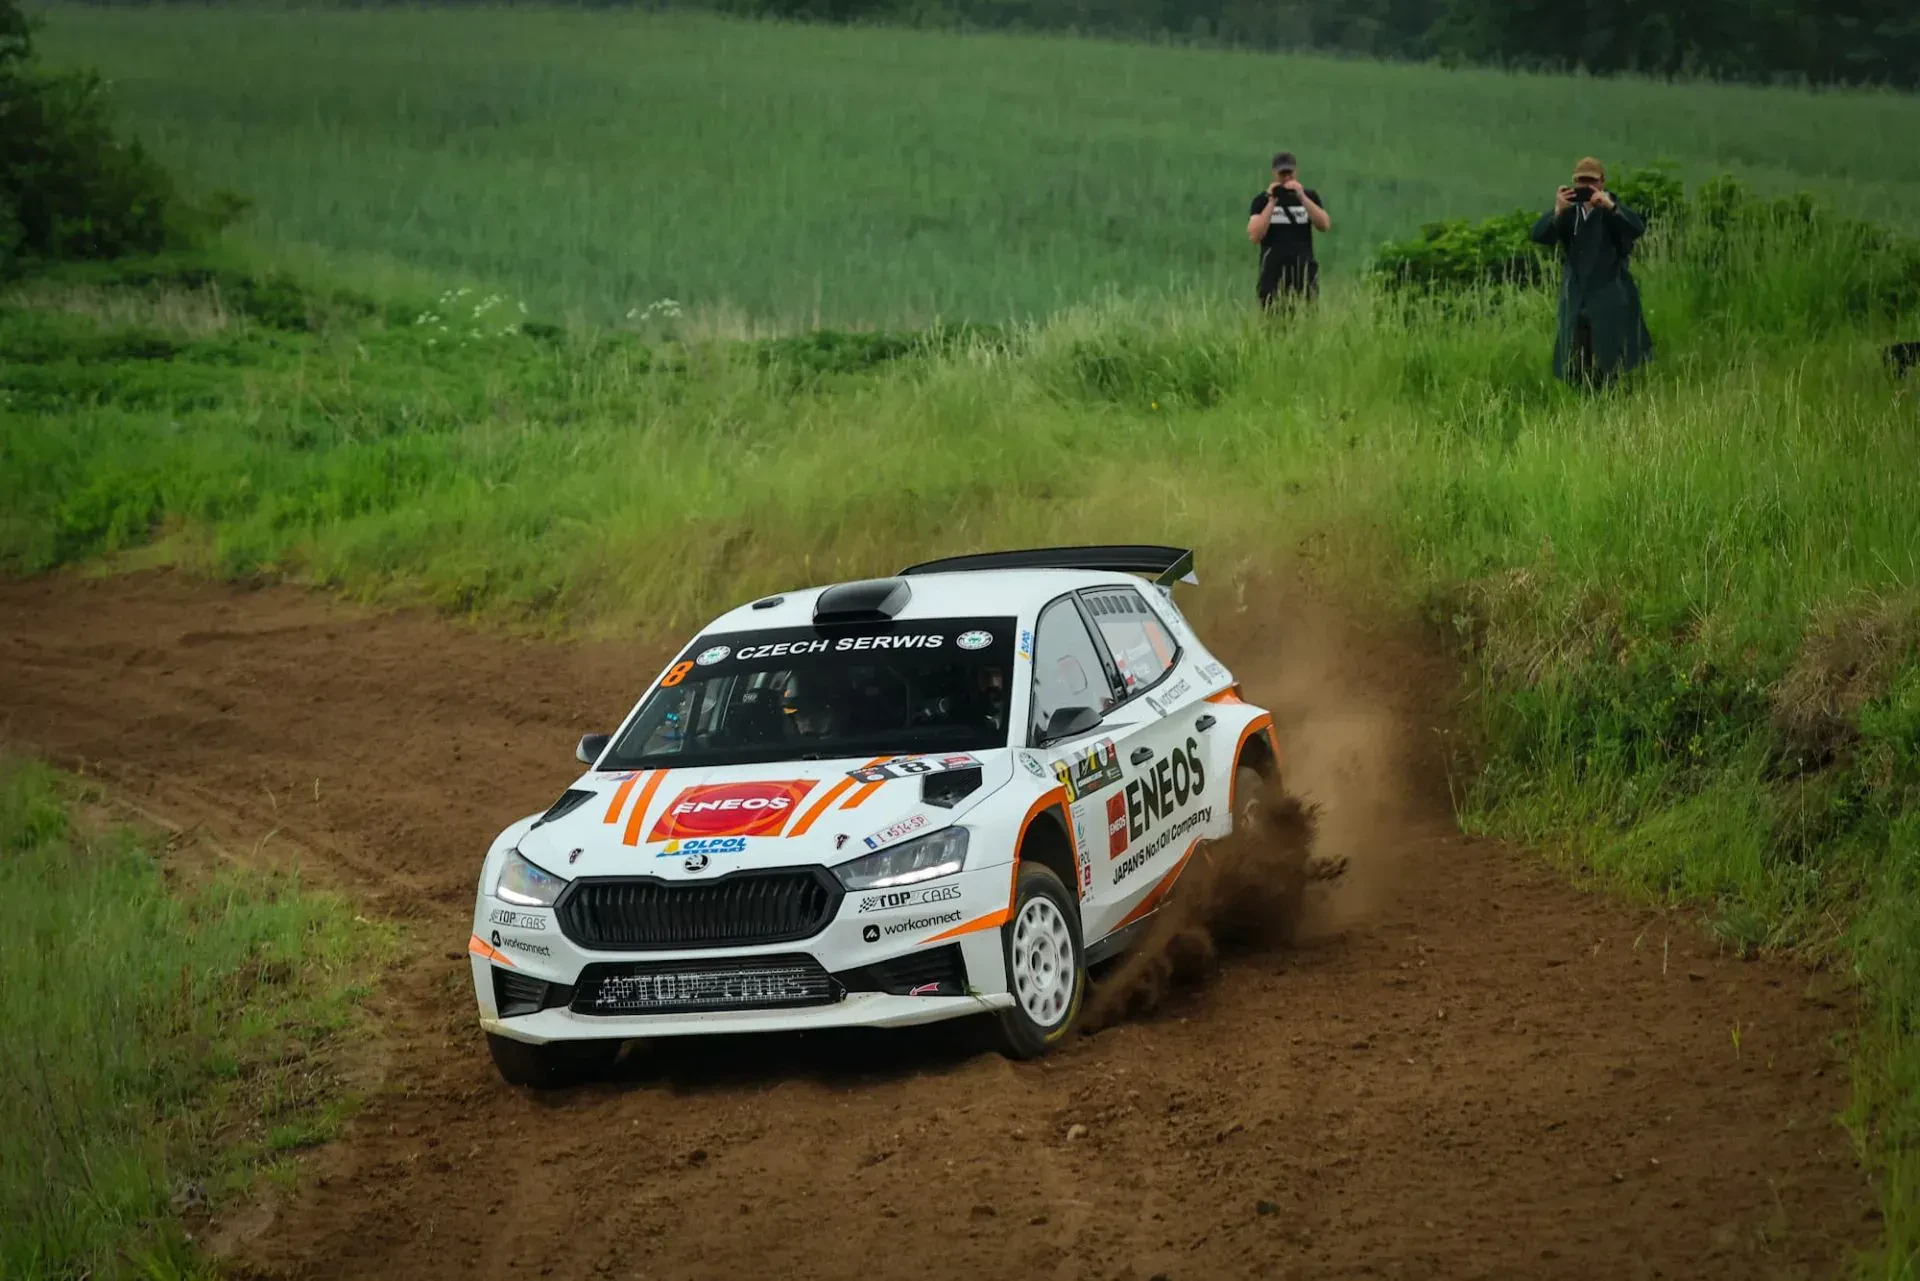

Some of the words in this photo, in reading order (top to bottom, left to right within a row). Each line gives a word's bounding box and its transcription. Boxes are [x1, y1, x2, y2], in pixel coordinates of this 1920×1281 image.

[735, 638, 829, 661] CZECH
[834, 634, 945, 651] SERWIS
[660, 660, 695, 687] 8
[898, 761, 932, 773] 8
[1126, 737, 1205, 843] ENEOS
[671, 796, 791, 816] ENEOS
[683, 837, 747, 851] OLPOL
[1145, 837, 1160, 862] No.1
[1160, 828, 1171, 849] Oil
[1171, 805, 1212, 840] Company
[880, 891, 911, 908] TOP
[921, 886, 962, 904] CARS
[499, 909, 516, 924] TOP
[884, 909, 963, 935] workconnect
[502, 937, 551, 957] workconnect
